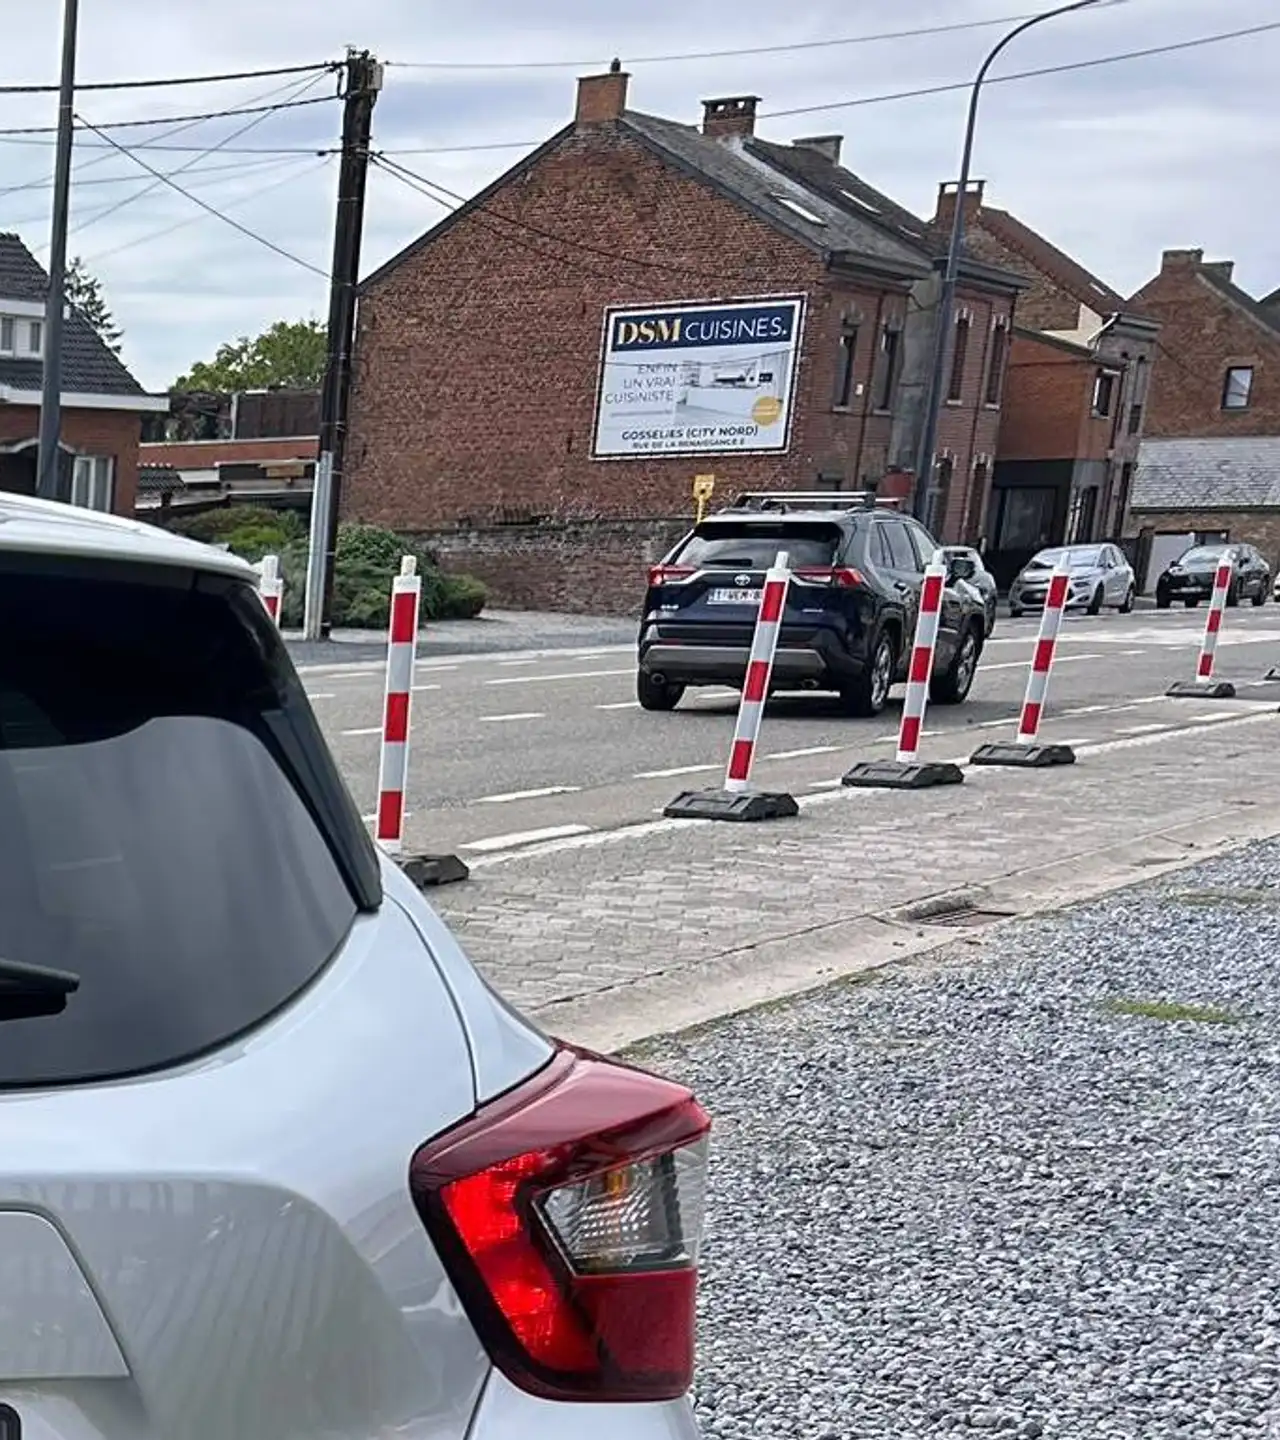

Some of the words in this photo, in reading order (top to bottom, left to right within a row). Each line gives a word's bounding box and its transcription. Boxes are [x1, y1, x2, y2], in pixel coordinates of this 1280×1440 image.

[616, 318, 682, 345] DSM
[684, 316, 788, 342] CUISINES.
[623, 378, 642, 389] UN
[646, 376, 676, 388] VRAI
[605, 390, 675, 404] CUISINISTE
[622, 428, 683, 440] GOSSELIES
[686, 426, 715, 439] (CITY
[719, 425, 758, 437] NORD)
